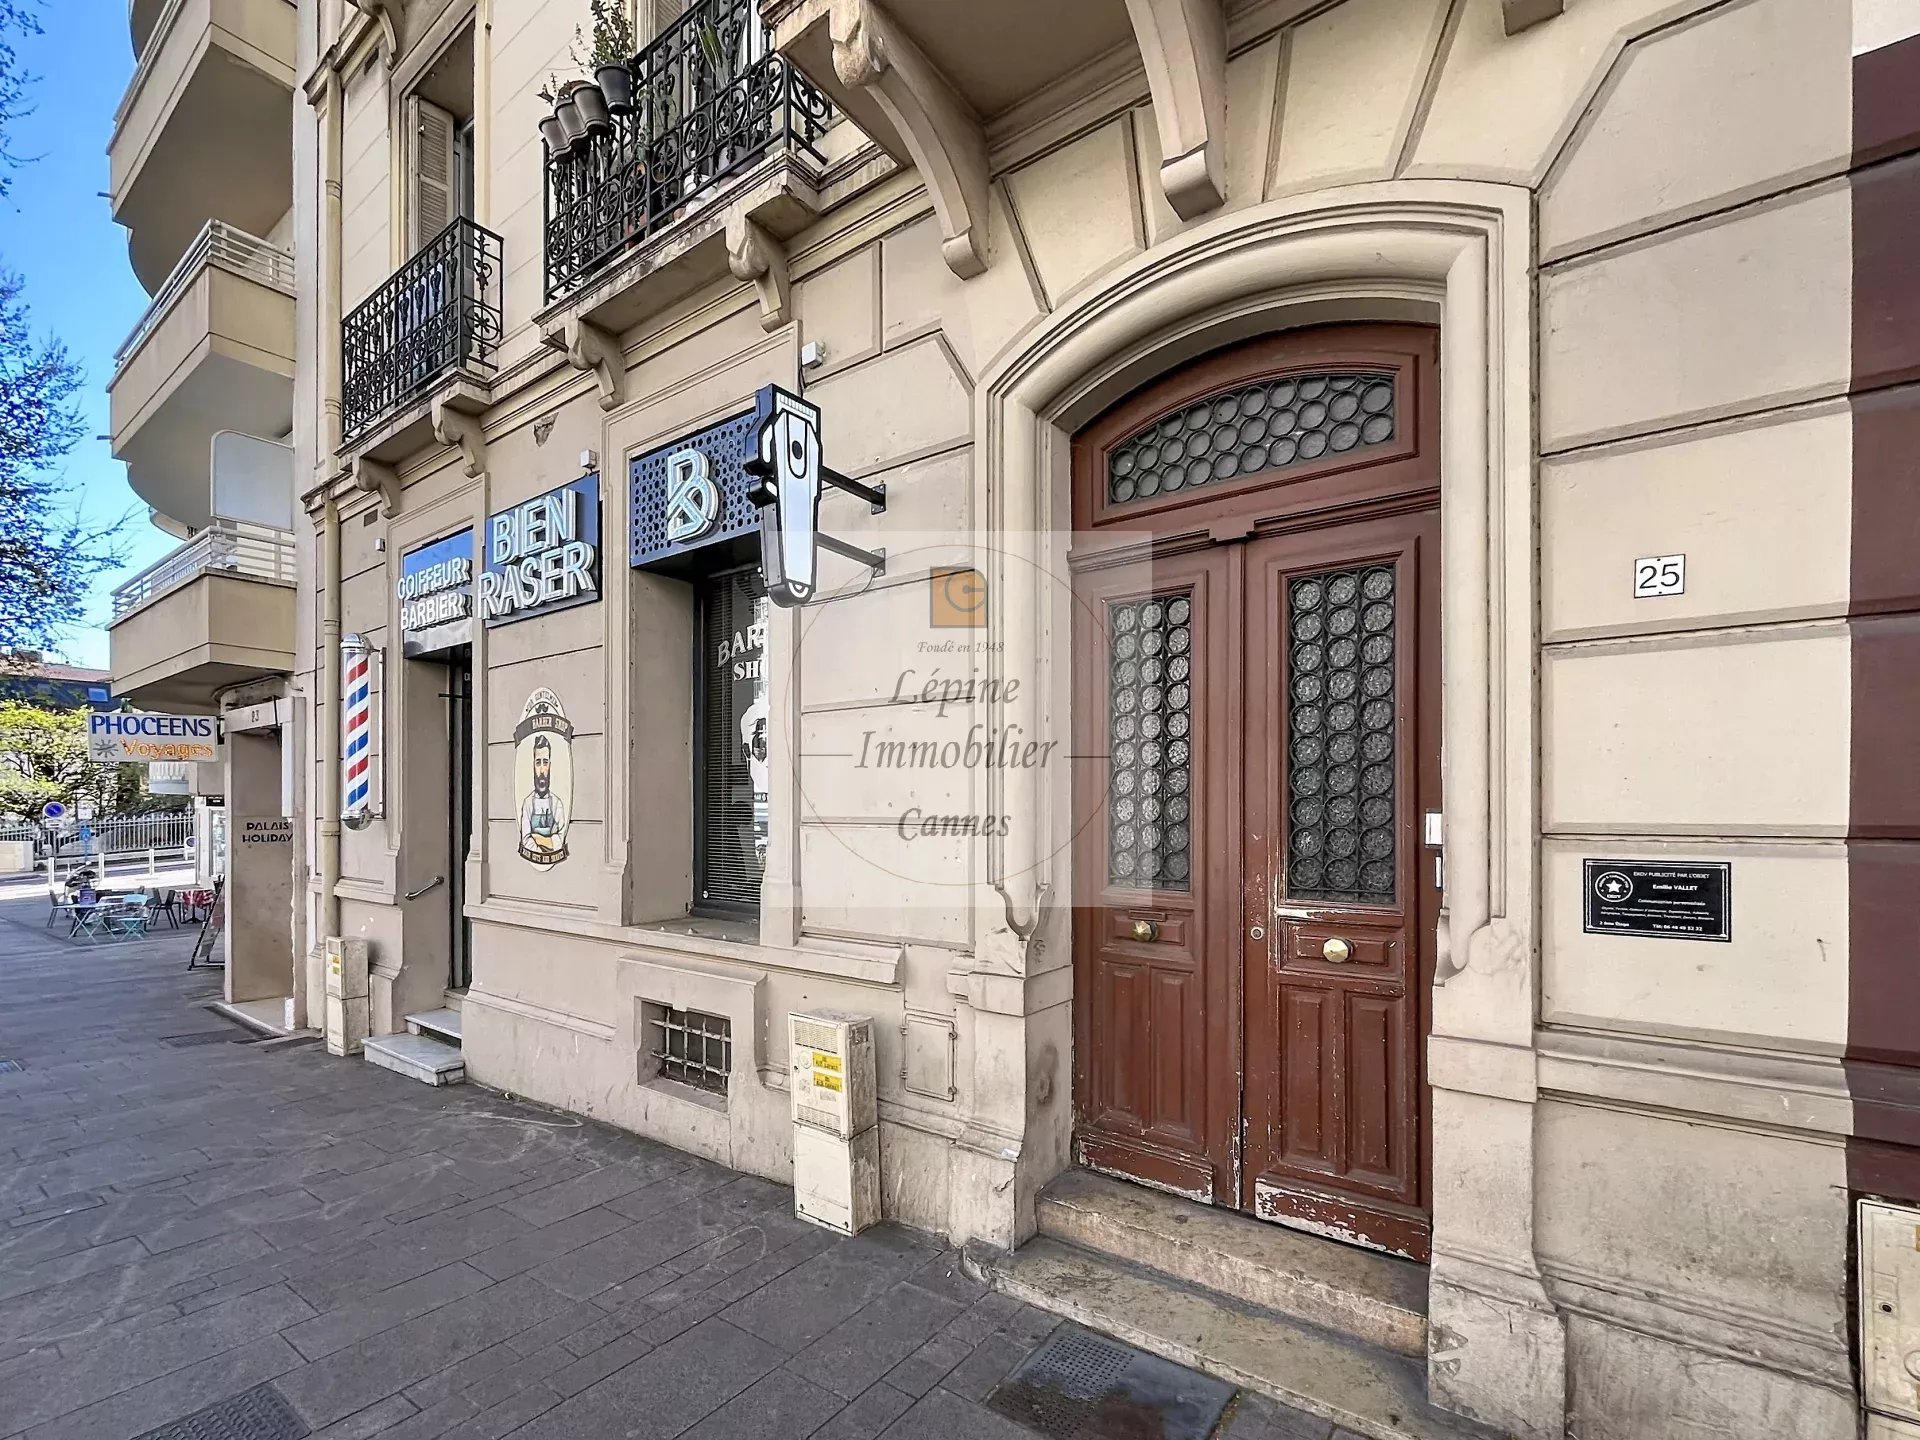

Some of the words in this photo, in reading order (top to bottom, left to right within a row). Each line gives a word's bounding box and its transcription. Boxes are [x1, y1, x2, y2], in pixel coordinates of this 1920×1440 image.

[493, 488, 577, 565] BIEN
[397, 557, 467, 600] COIFFEUR
[478, 541, 596, 620] RASER
[1639, 563, 1680, 589] 25
[401, 592, 467, 631] BARBIER
[717, 622, 767, 668] BAR
[733, 659, 767, 681] SH
[91, 715, 212, 737] PHOCEENS
[119, 736, 212, 761] Voyages
[242, 833, 293, 843] HOLIDAY
[246, 821, 289, 831] PALAIS
